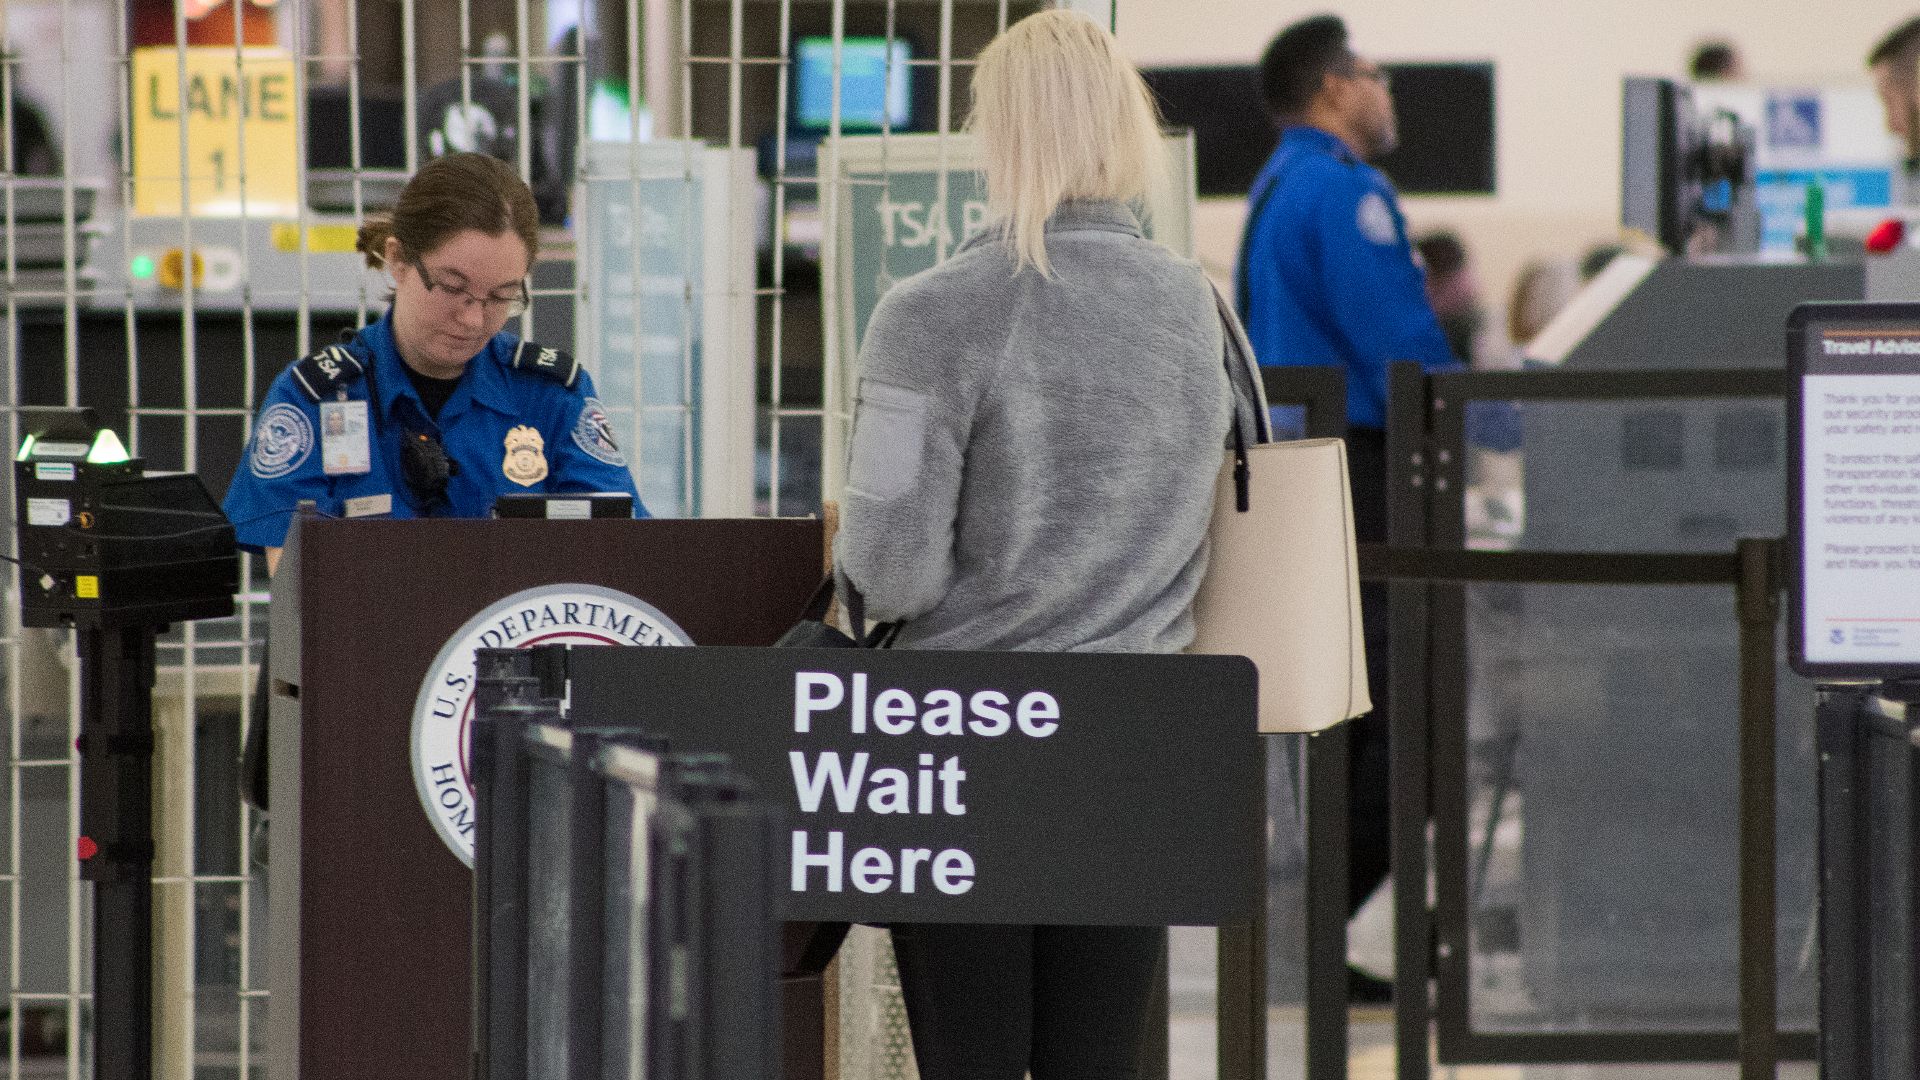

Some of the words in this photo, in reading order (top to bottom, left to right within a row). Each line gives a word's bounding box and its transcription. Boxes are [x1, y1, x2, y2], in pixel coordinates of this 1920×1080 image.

[148, 74, 288, 120] LANE
[209, 149, 225, 192] 1
[877, 202, 953, 247] TSA
[313, 350, 341, 380] TSA
[536, 347, 559, 366] TSA
[1822, 339, 1870, 354] Travel
[1824, 393, 1857, 405] Thank
[1862, 395, 1882, 407] you
[1885, 393, 1900, 405] for
[1846, 408, 1889, 421] security
[433, 672, 473, 719] U.S.
[794, 671, 1060, 738] Please
[431, 762, 475, 848] HOM
[788, 751, 967, 816] Wait
[791, 830, 976, 895] Here
